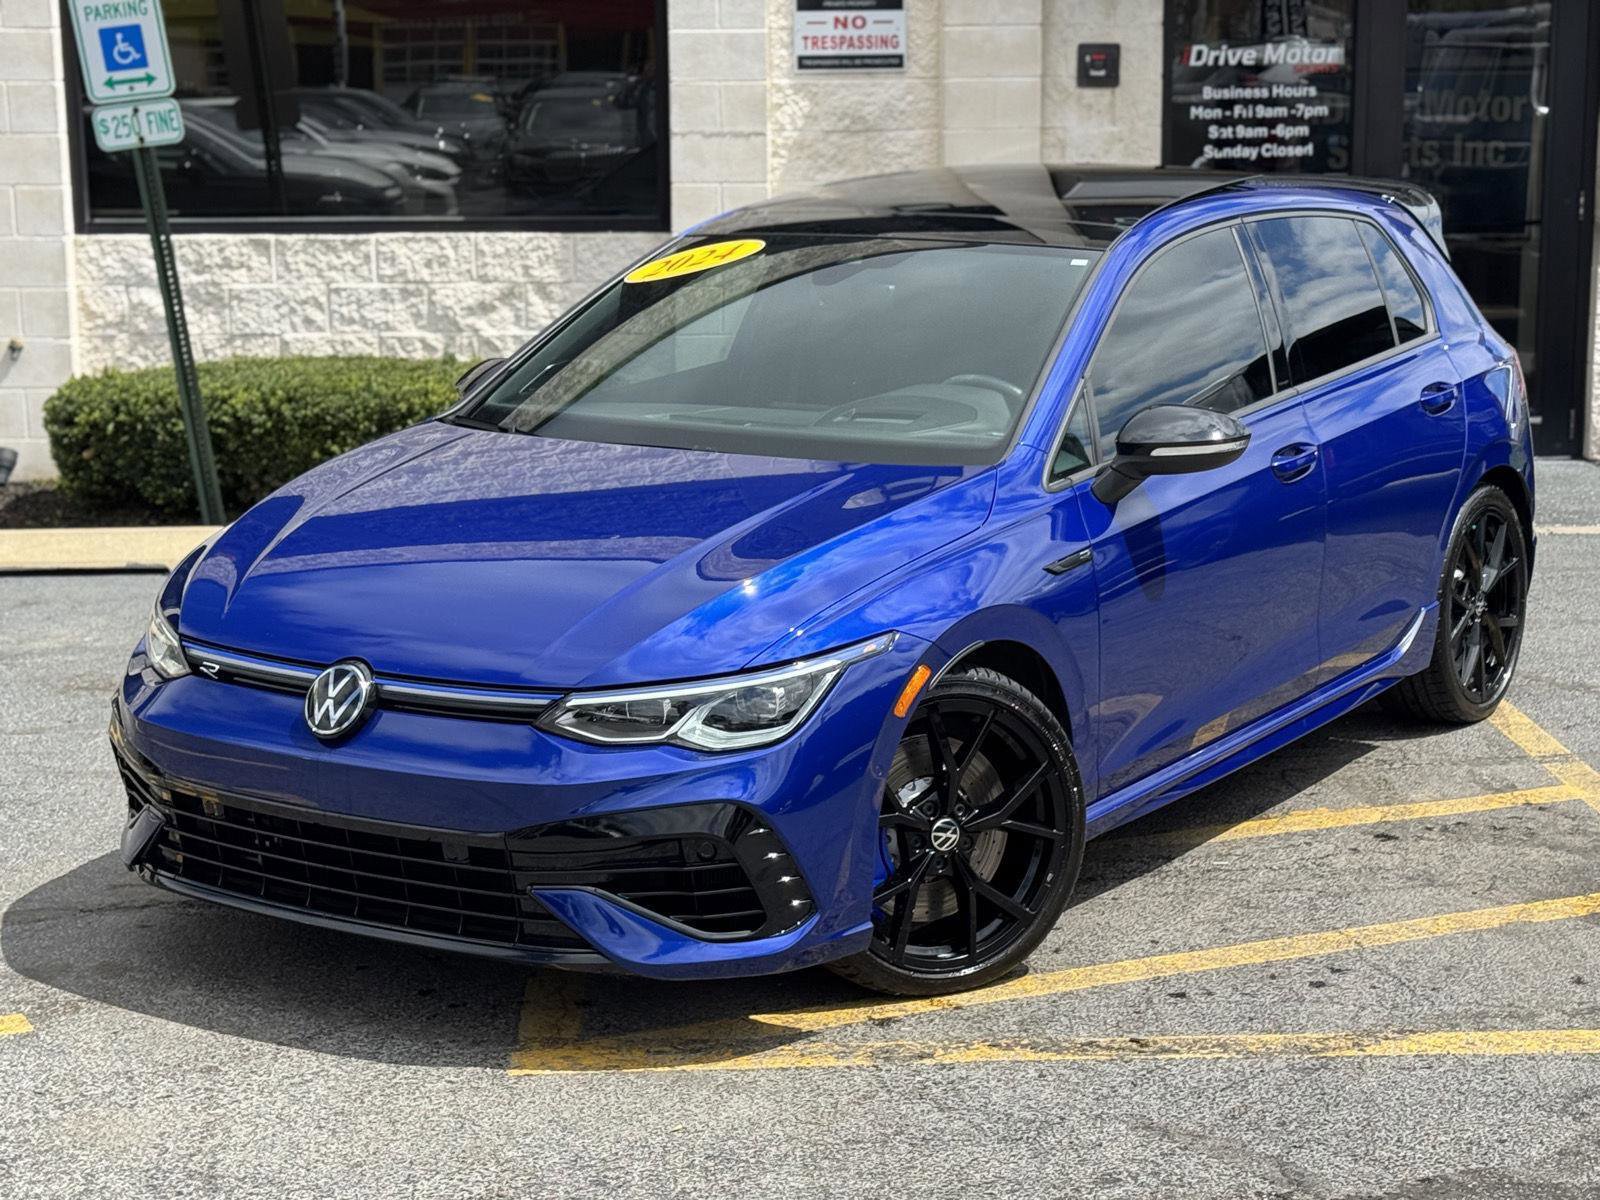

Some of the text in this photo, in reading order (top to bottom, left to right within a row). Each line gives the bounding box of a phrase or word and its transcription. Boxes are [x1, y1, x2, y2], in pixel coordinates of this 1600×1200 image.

[84, 2, 148, 22] PARKING
[833, 15, 867, 30] NO
[802, 34, 900, 50] TRESPASSING
[1202, 84, 1317, 100] Business Hours
[1189, 105, 1222, 120] Mon
[1233, 104, 1254, 119] Fri
[1255, 103, 1288, 119] 9am
[146, 109, 179, 135] FINE
[1208, 124, 1234, 139] Sat
[1235, 124, 1268, 139] 9am
[1203, 143, 1260, 161] Sunday
